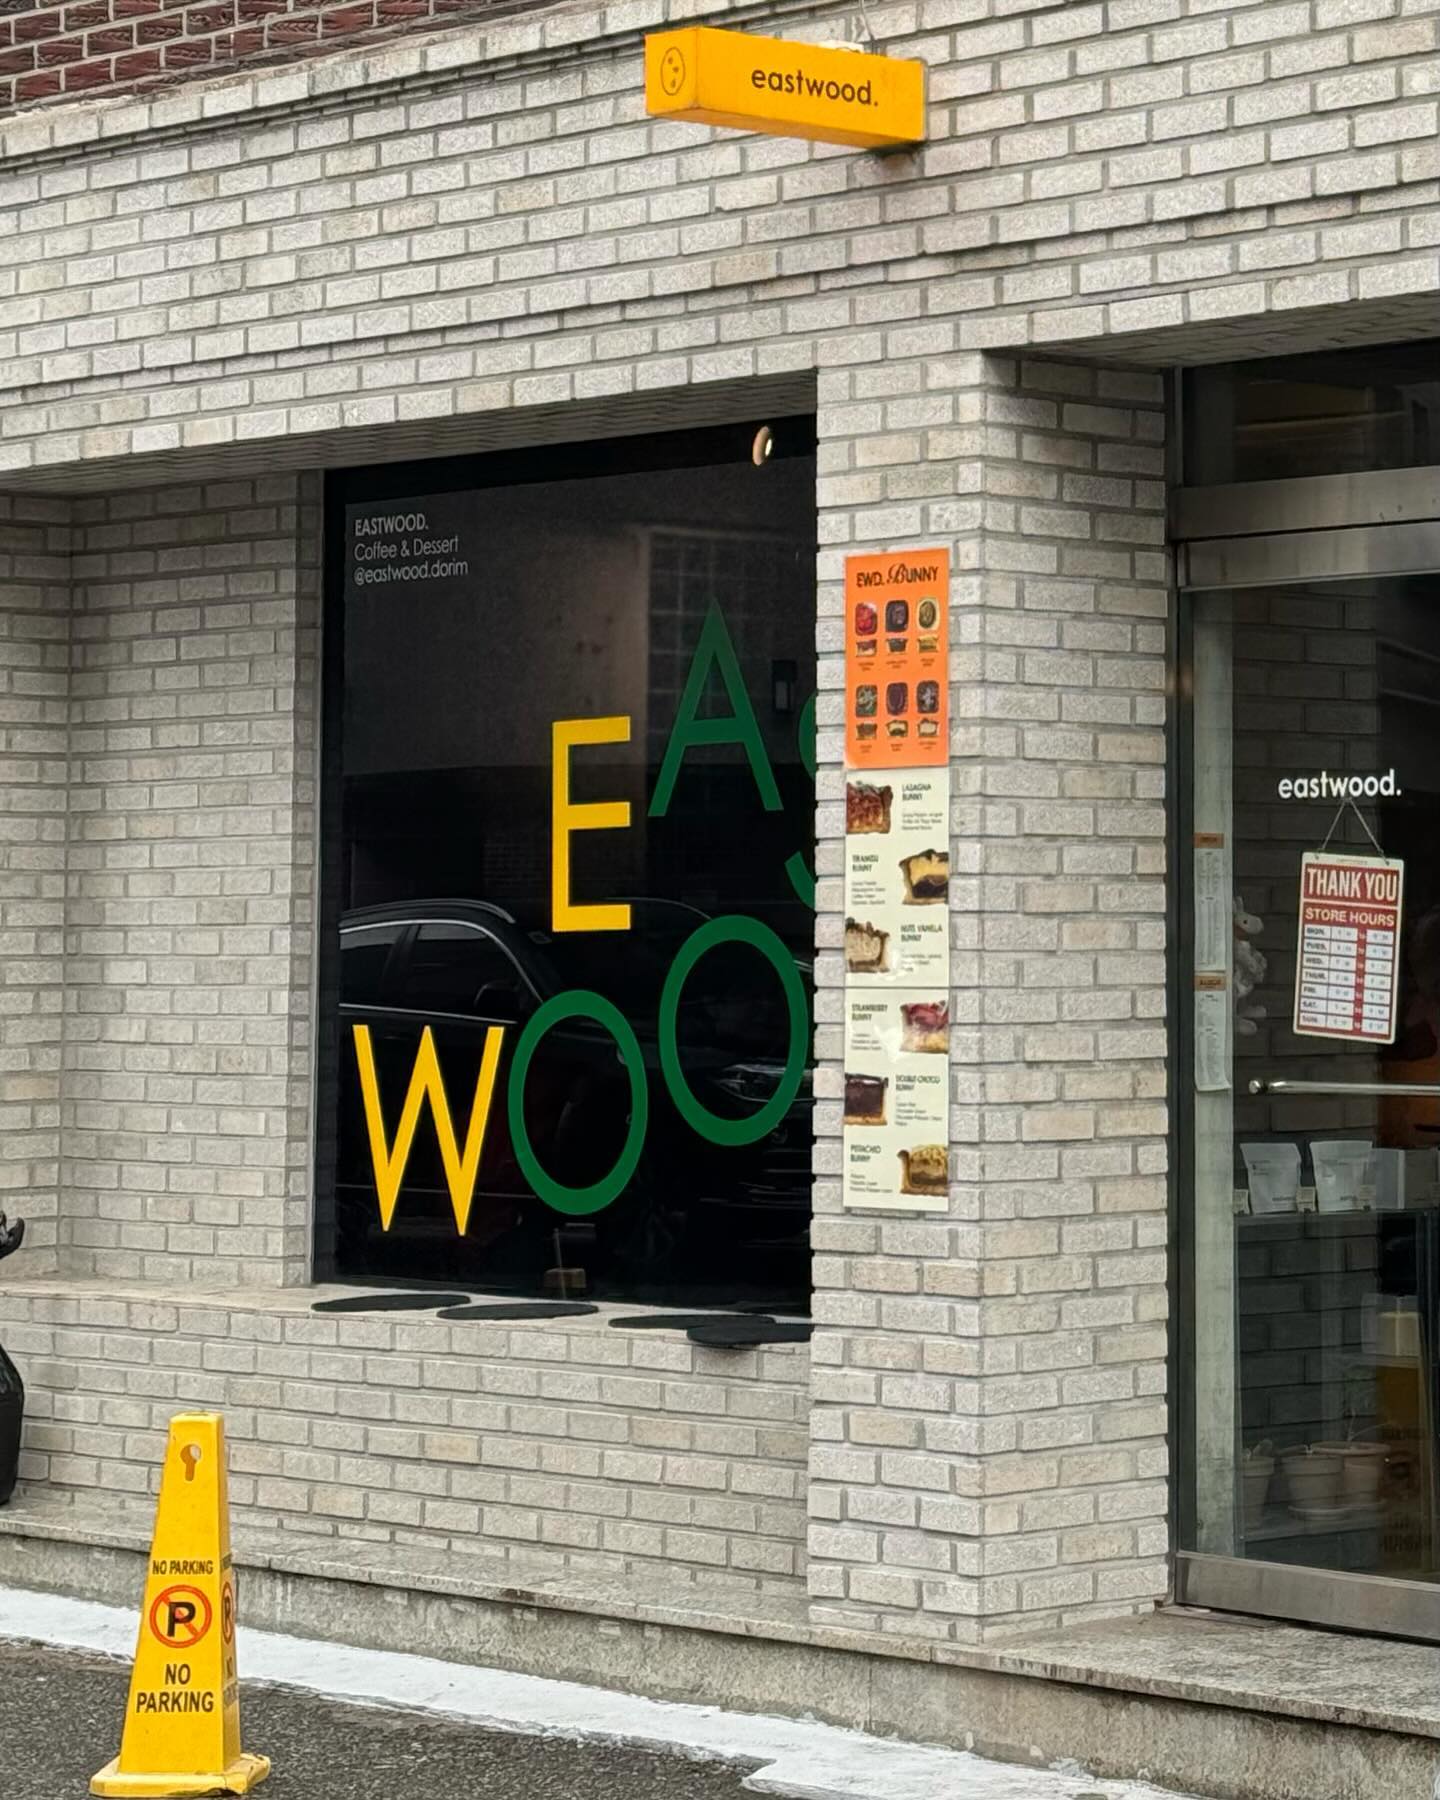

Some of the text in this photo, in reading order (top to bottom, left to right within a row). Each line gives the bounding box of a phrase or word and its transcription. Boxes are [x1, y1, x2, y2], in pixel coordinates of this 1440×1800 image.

[751, 69, 879, 107] eastwood.
[354, 513, 429, 537] EASTWOOD.
[354, 535, 459, 562] Coffee & Dessert
[856, 570, 885, 588] EWD.
[1277, 768, 1402, 798] eastwood.
[1306, 868, 1398, 902] THANK YOU
[1304, 907, 1395, 927] STORE HOURS
[152, 1560, 167, 1575] NO
[169, 1560, 214, 1575] PARKING
[165, 1663, 191, 1685] NO
[136, 1691, 214, 1713] PARKING
